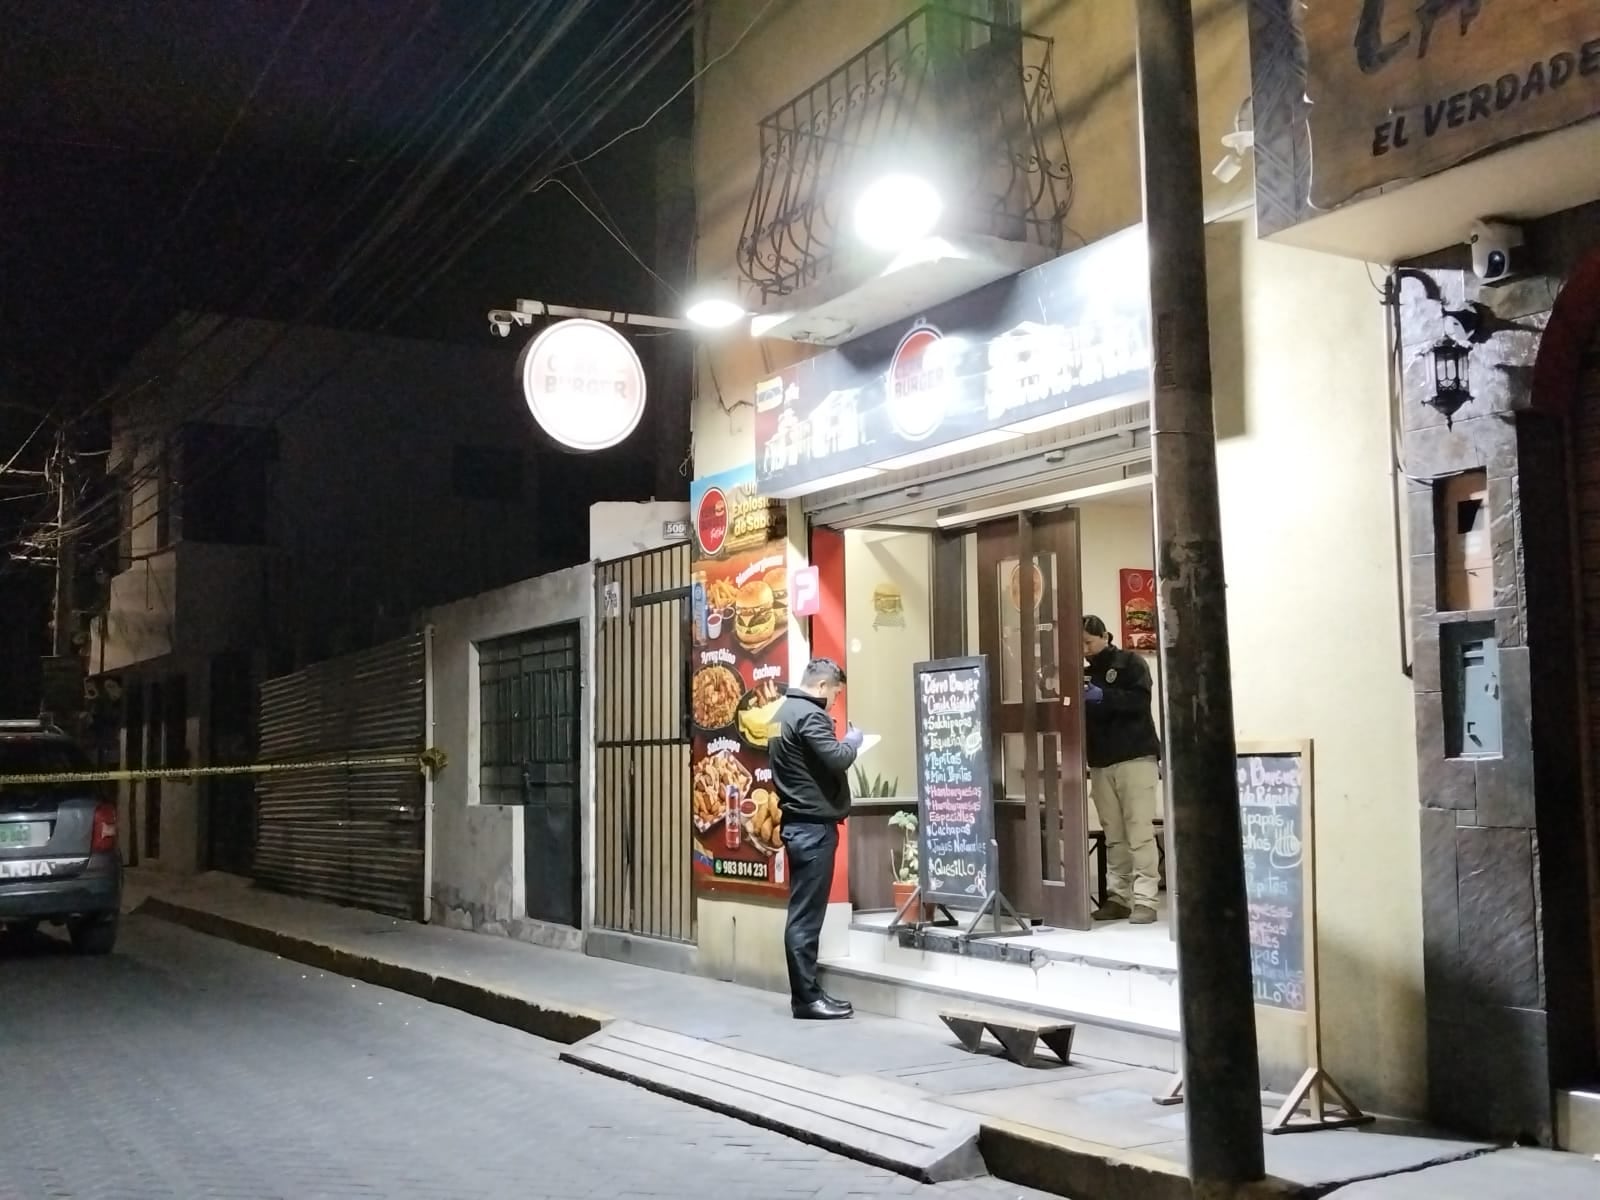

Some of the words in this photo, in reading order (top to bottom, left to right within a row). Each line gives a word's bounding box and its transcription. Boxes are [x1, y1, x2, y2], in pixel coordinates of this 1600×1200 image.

[1371, 117, 1409, 157] EL
[894, 366, 944, 399] BURGER
[734, 519, 747, 537] de
[746, 511, 776, 533] Sabor
[753, 863, 768, 878] 231
